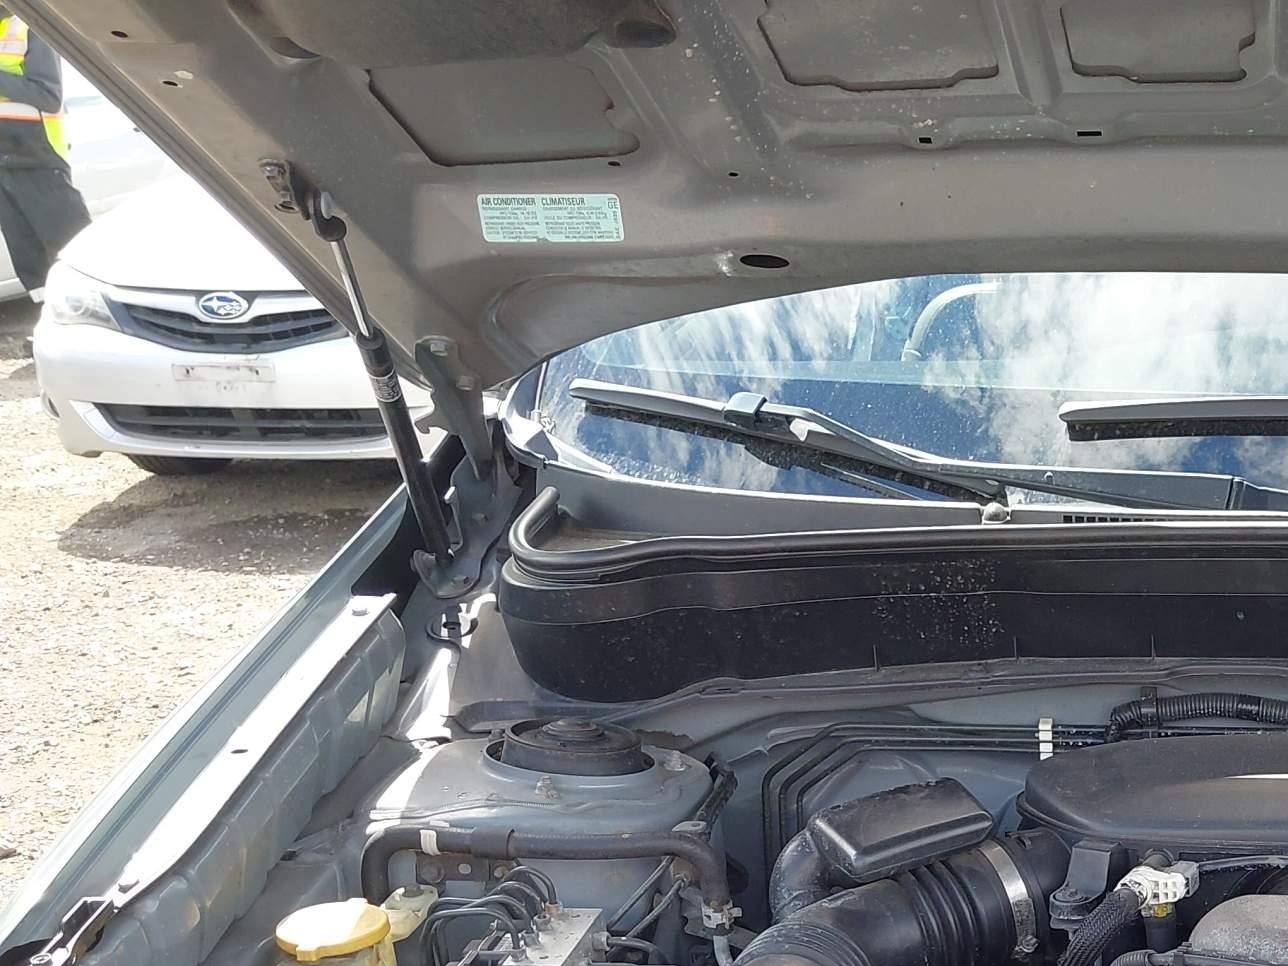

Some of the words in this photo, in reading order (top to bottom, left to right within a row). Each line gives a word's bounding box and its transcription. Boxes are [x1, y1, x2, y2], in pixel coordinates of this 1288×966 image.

[481, 197, 492, 206] AIR
[493, 197, 536, 206] CONDITIONER
[541, 197, 586, 206] CLIMATISEUR
